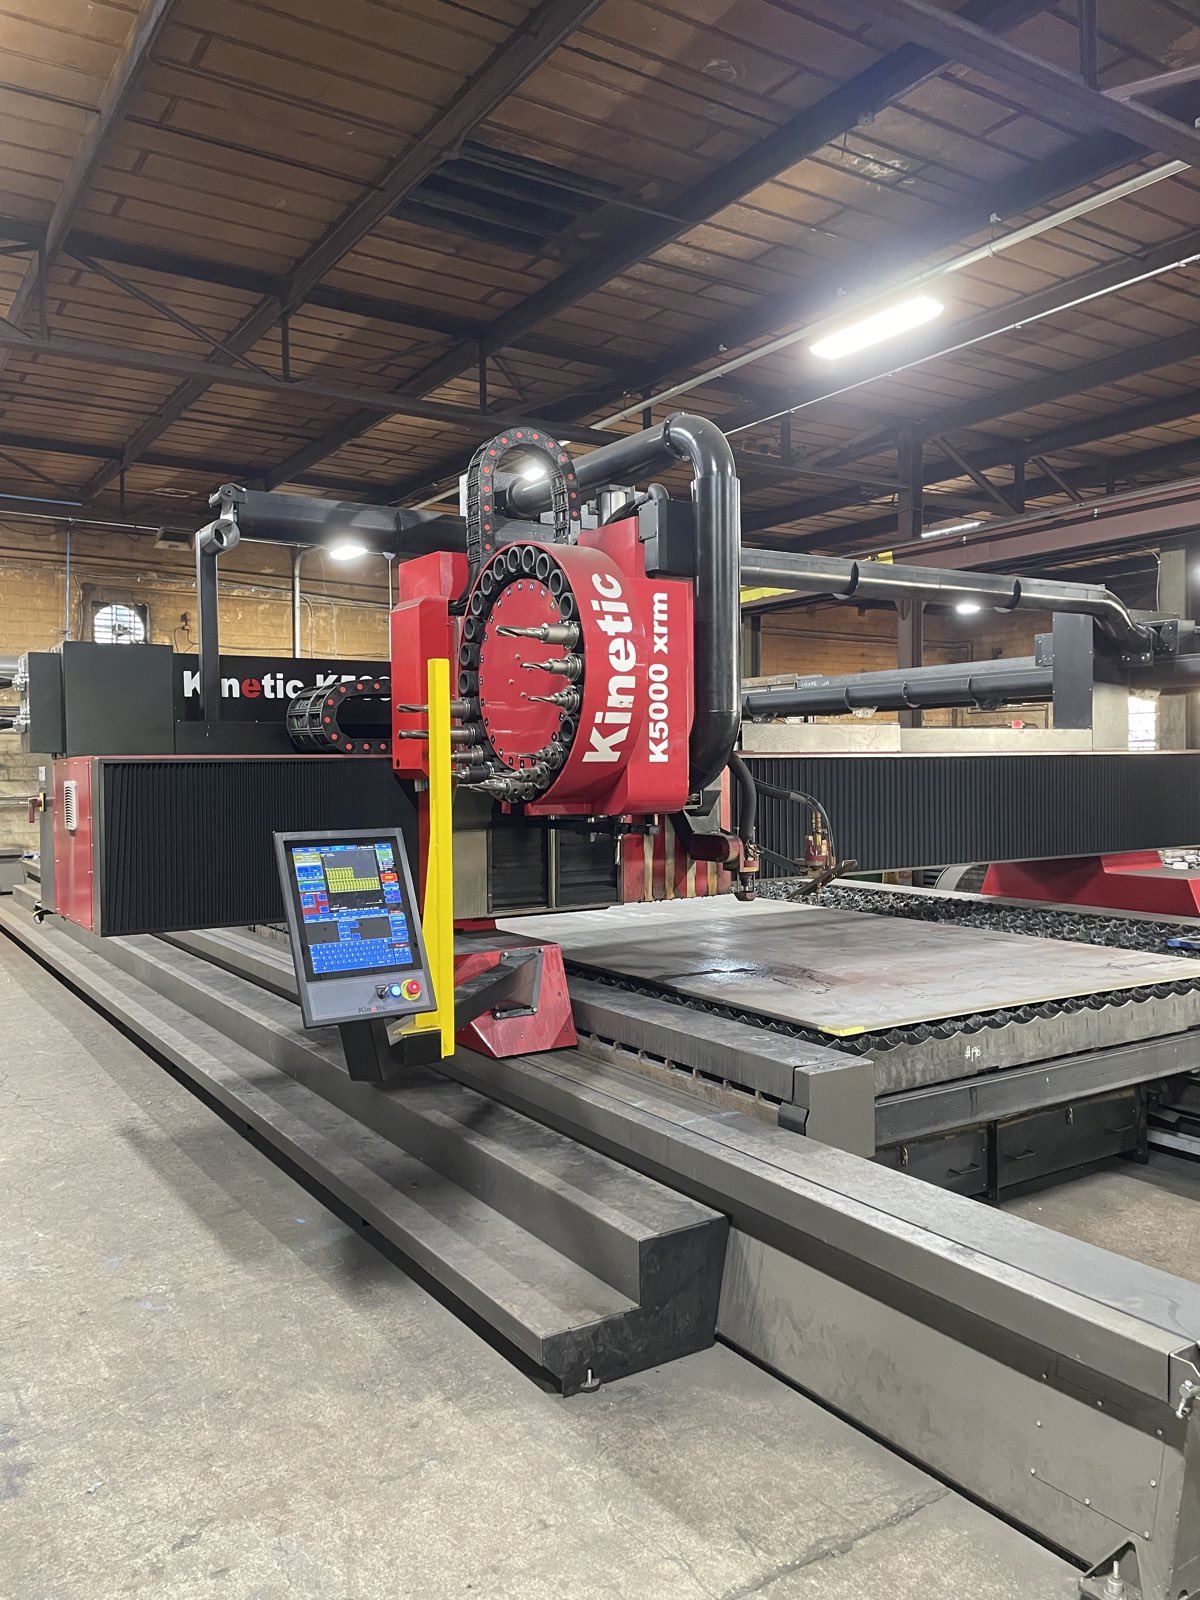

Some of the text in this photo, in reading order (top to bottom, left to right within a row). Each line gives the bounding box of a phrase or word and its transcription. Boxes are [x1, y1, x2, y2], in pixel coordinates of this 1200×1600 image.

[182, 670, 304, 699] Knetic
[581, 572, 637, 763] Kinetic
[648, 592, 670, 763] K5000 xrm
